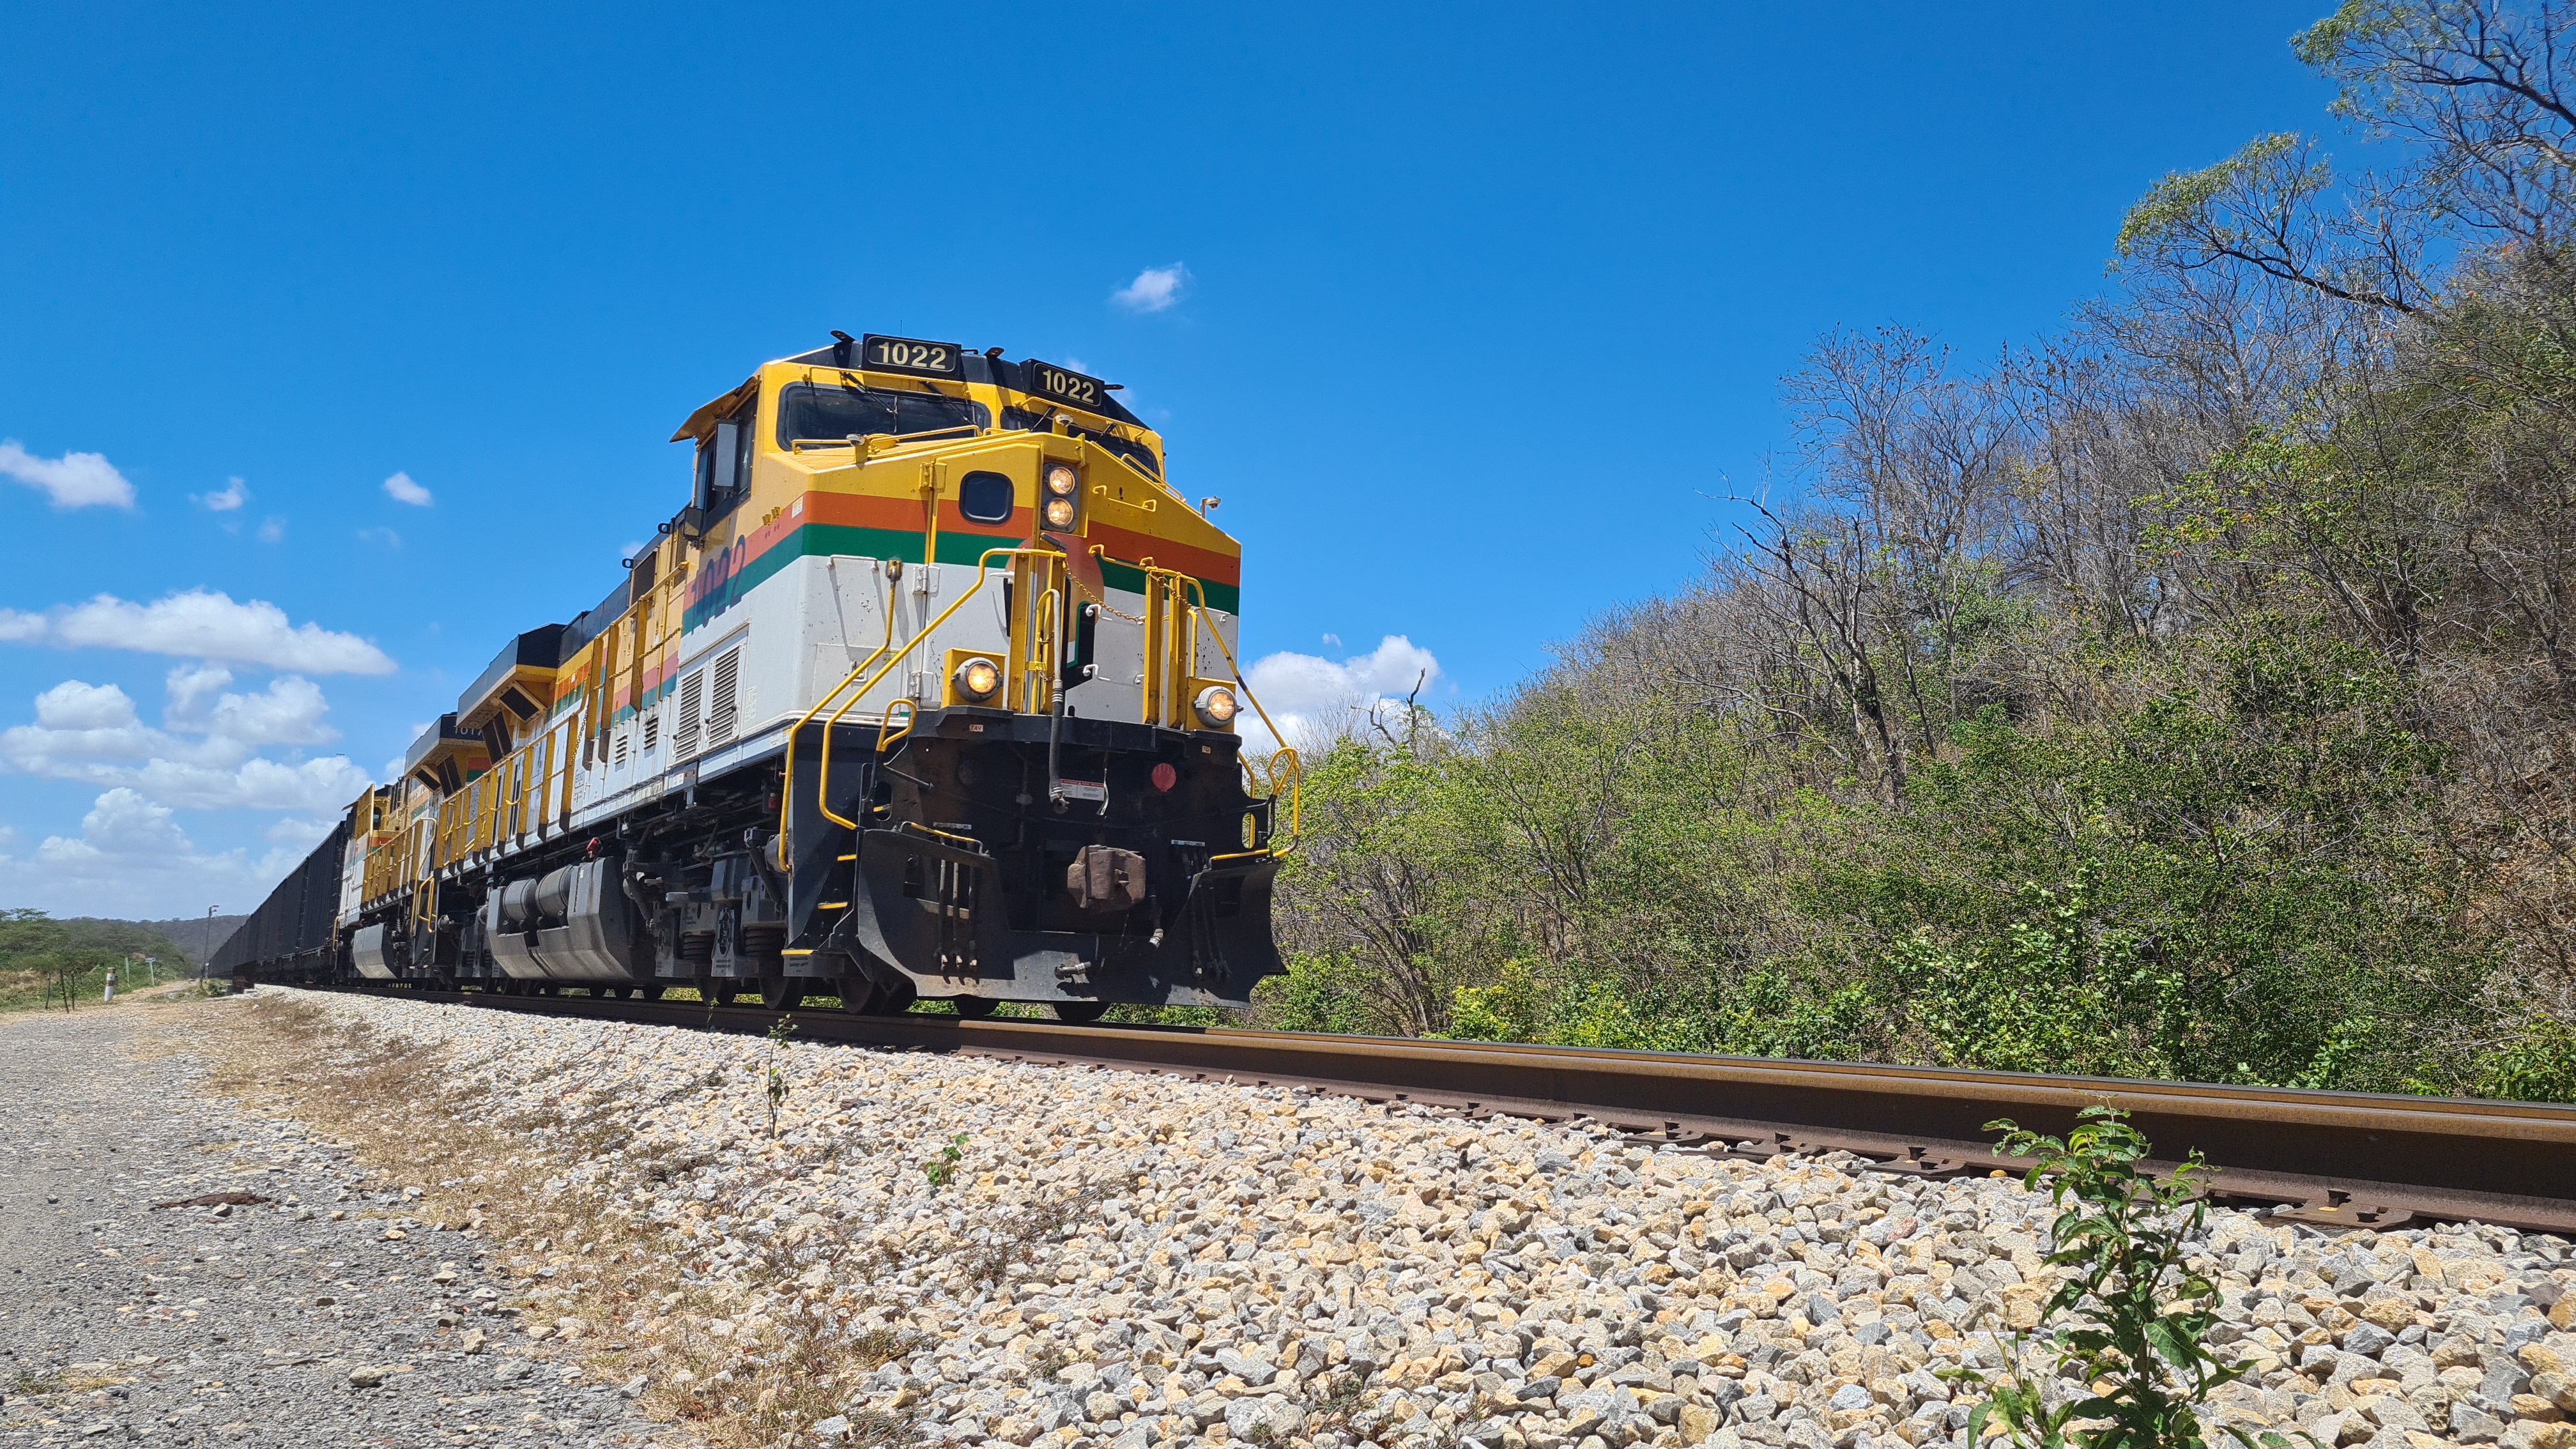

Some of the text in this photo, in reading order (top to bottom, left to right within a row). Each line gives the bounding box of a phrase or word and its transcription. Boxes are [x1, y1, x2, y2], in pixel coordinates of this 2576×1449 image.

[878, 342, 947, 370] 1022
[1043, 369, 1094, 404] 1022
[691, 534, 746, 636] 1022
